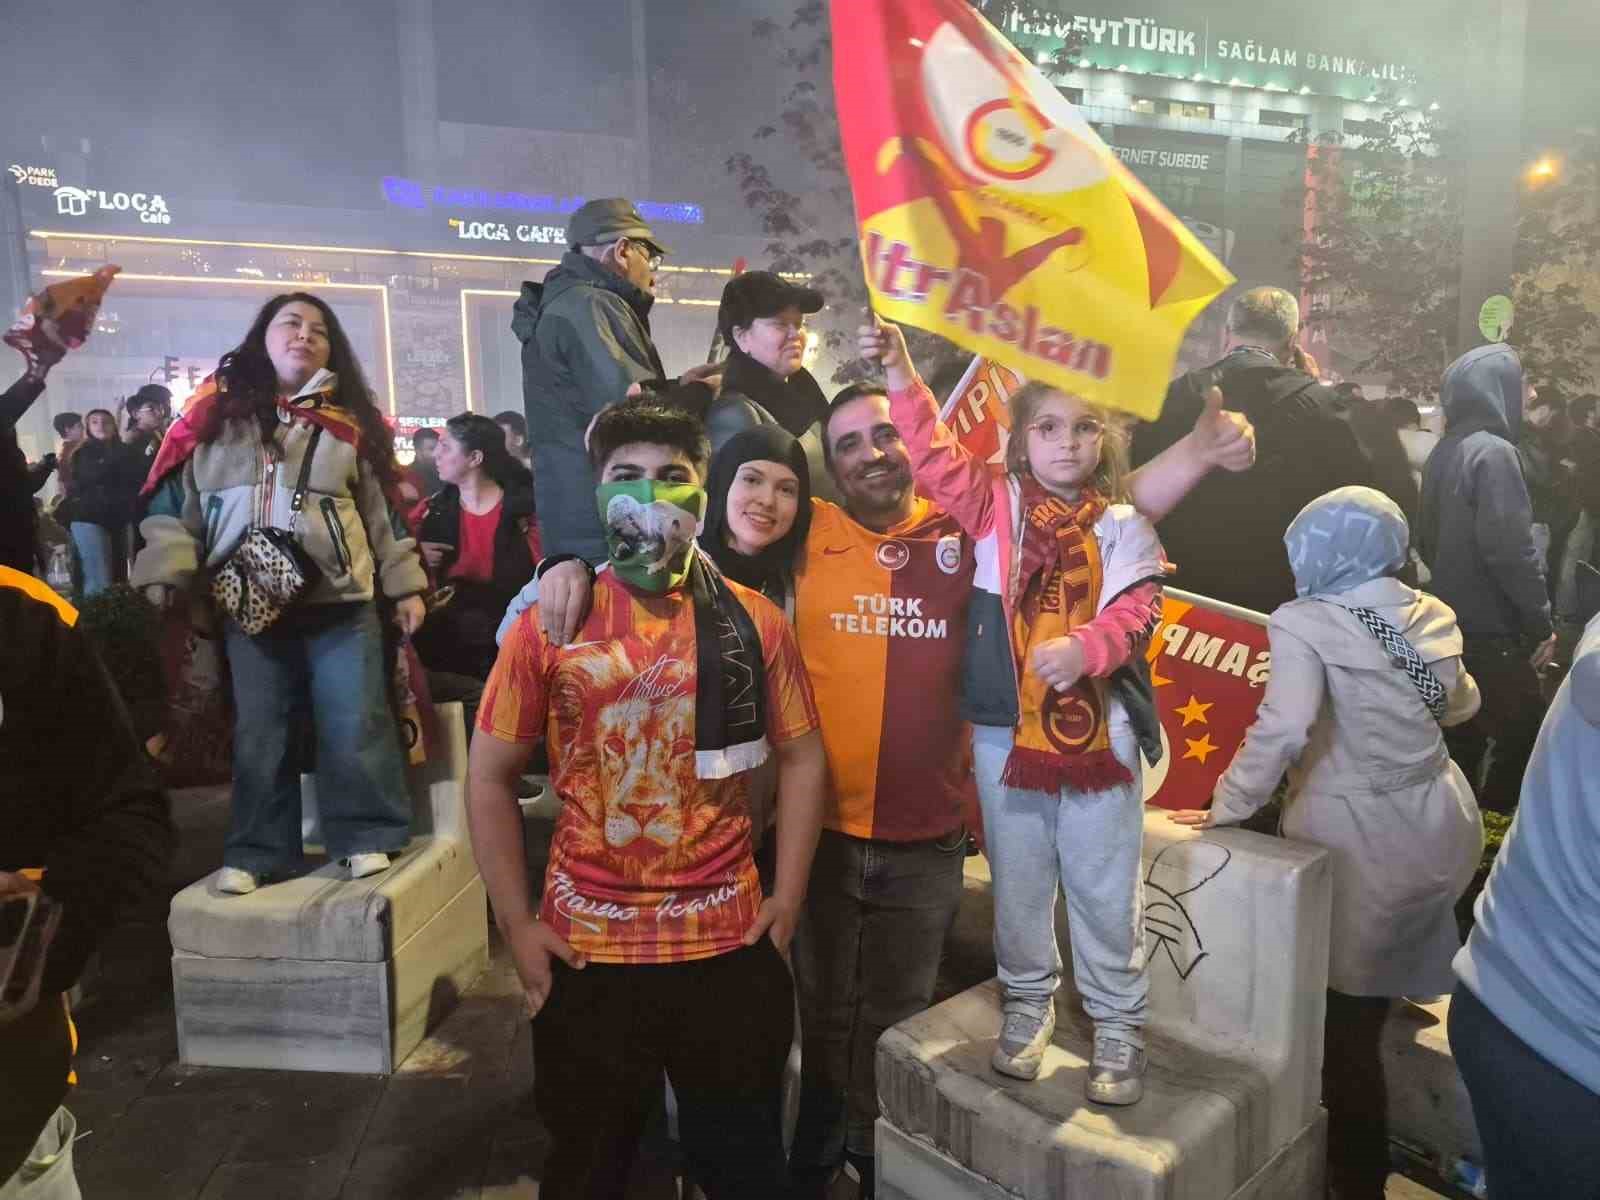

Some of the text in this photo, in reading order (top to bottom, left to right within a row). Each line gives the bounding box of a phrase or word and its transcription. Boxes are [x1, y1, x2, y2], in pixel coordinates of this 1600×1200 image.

[1217, 39, 1297, 66] SAĞLAM
[27, 166, 56, 178] PARK
[1158, 151, 1209, 170] SUBEDE
[98, 191, 169, 213] LOCA
[140, 211, 171, 224] Cafe
[458, 220, 568, 245] LOCA CAFE
[853, 593, 924, 617] TÜRK
[830, 612, 948, 638] TELEKOM
